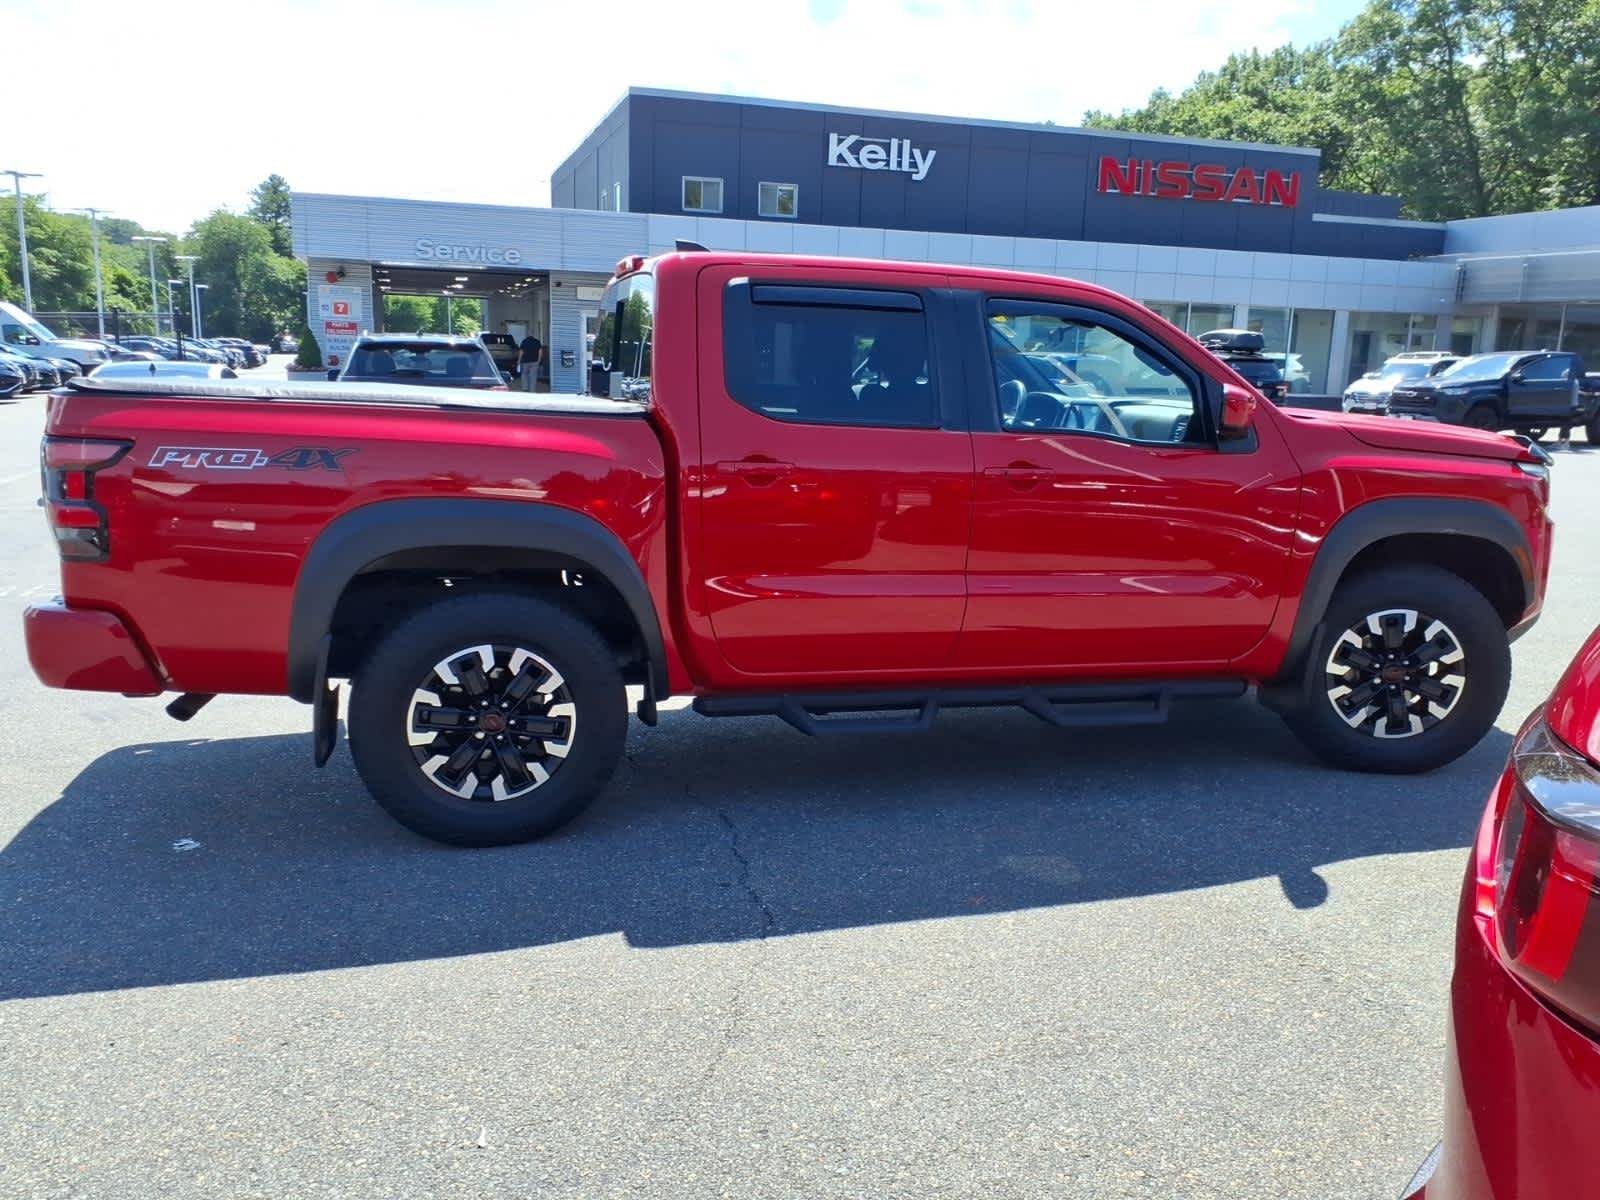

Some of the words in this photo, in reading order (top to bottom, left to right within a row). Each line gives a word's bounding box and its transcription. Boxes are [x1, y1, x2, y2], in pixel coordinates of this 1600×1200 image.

[828, 133, 937, 181] Kelly
[1097, 155, 1301, 208] NISSAN
[415, 238, 521, 264] Service
[336, 303, 345, 313] 7
